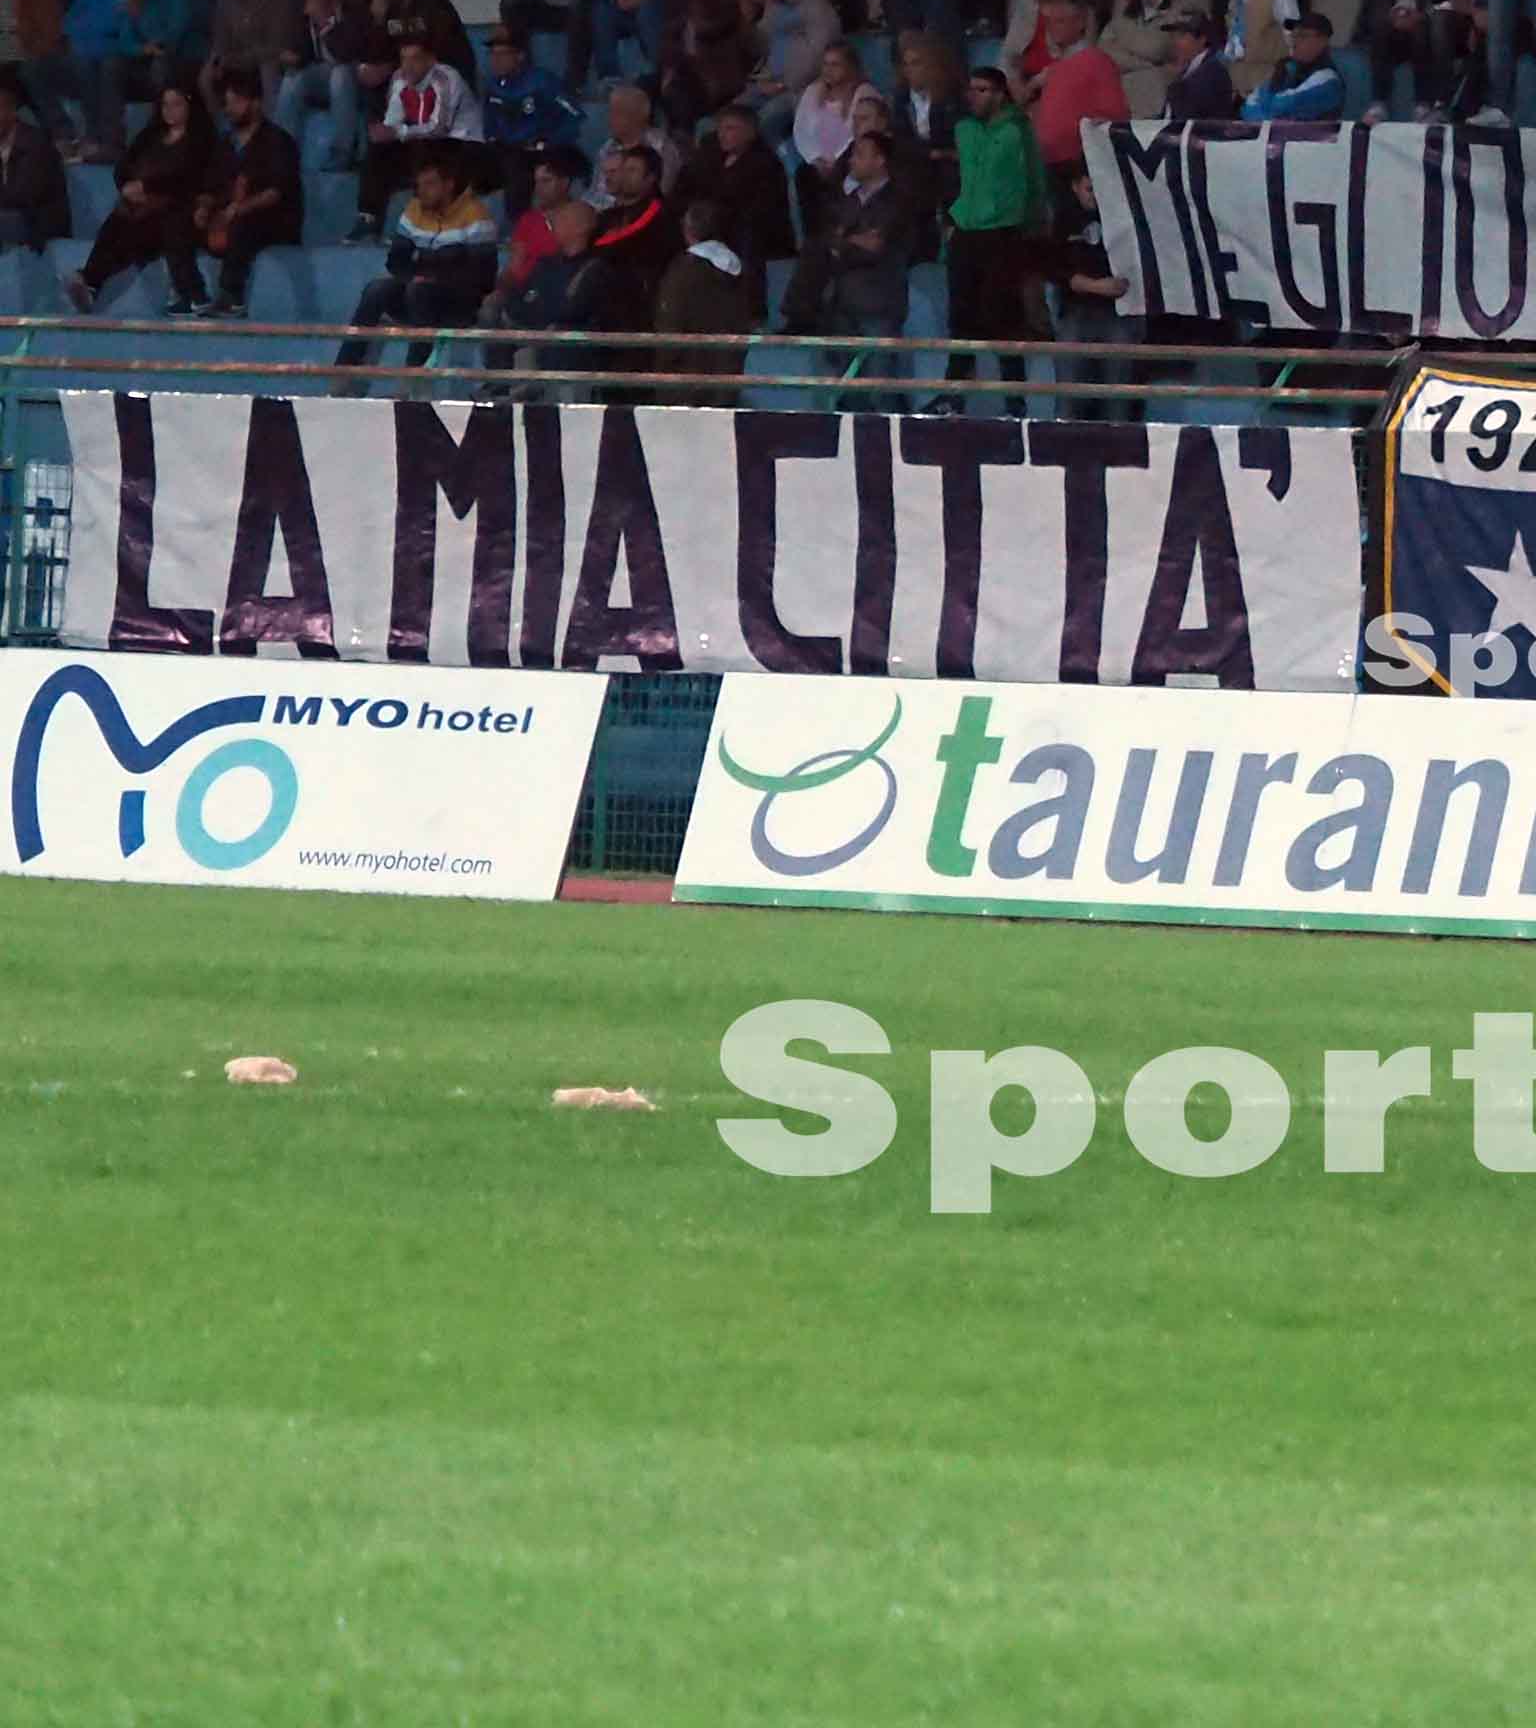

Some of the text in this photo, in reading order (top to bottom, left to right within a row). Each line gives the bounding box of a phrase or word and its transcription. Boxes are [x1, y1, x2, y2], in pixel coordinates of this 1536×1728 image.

[1108, 119, 1528, 340] MEGLIO
[108, 391, 340, 660] LA
[387, 401, 684, 672] MIA
[272, 695, 533, 735] MYO hotel
[298, 847, 493, 877] www.myohotel.com
